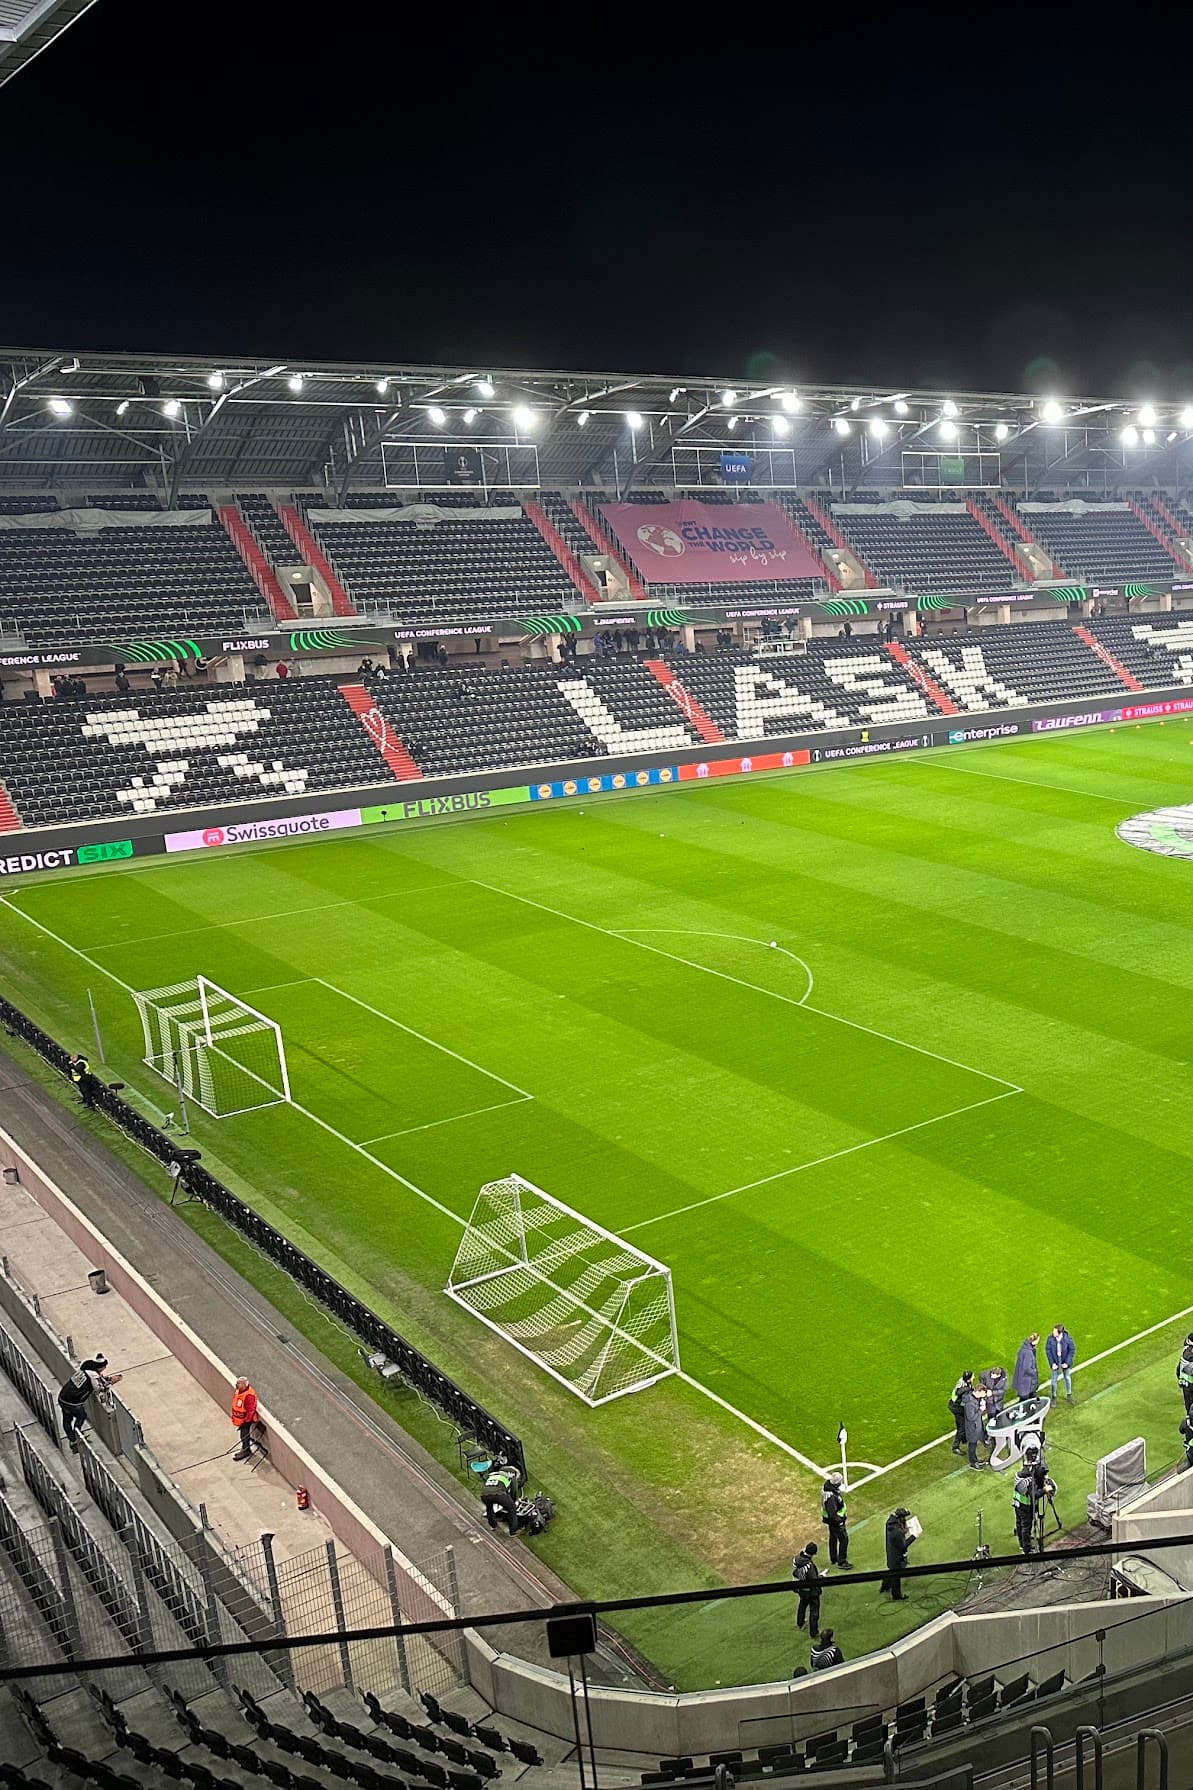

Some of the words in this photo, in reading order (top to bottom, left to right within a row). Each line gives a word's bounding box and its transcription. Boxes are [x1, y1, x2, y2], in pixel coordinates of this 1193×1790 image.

[725, 464, 746, 472] UEFA
[682, 527, 767, 542] CHANGE
[706, 540, 775, 553] WORLD
[729, 553, 748, 566] sip
[750, 547, 767, 566] by
[770, 550, 787, 561] sip
[395, 630, 415, 639] UEFA
[416, 627, 463, 638] CONFERENCE
[1134, 704, 1163, 716] STRAUSS
[951, 723, 1019, 743] enterprise
[824, 750, 844, 759] UEFA
[845, 742, 892, 756] CONFERENCE
[226, 816, 330, 843] Swissquote
[83, 843, 129, 861] SIX
